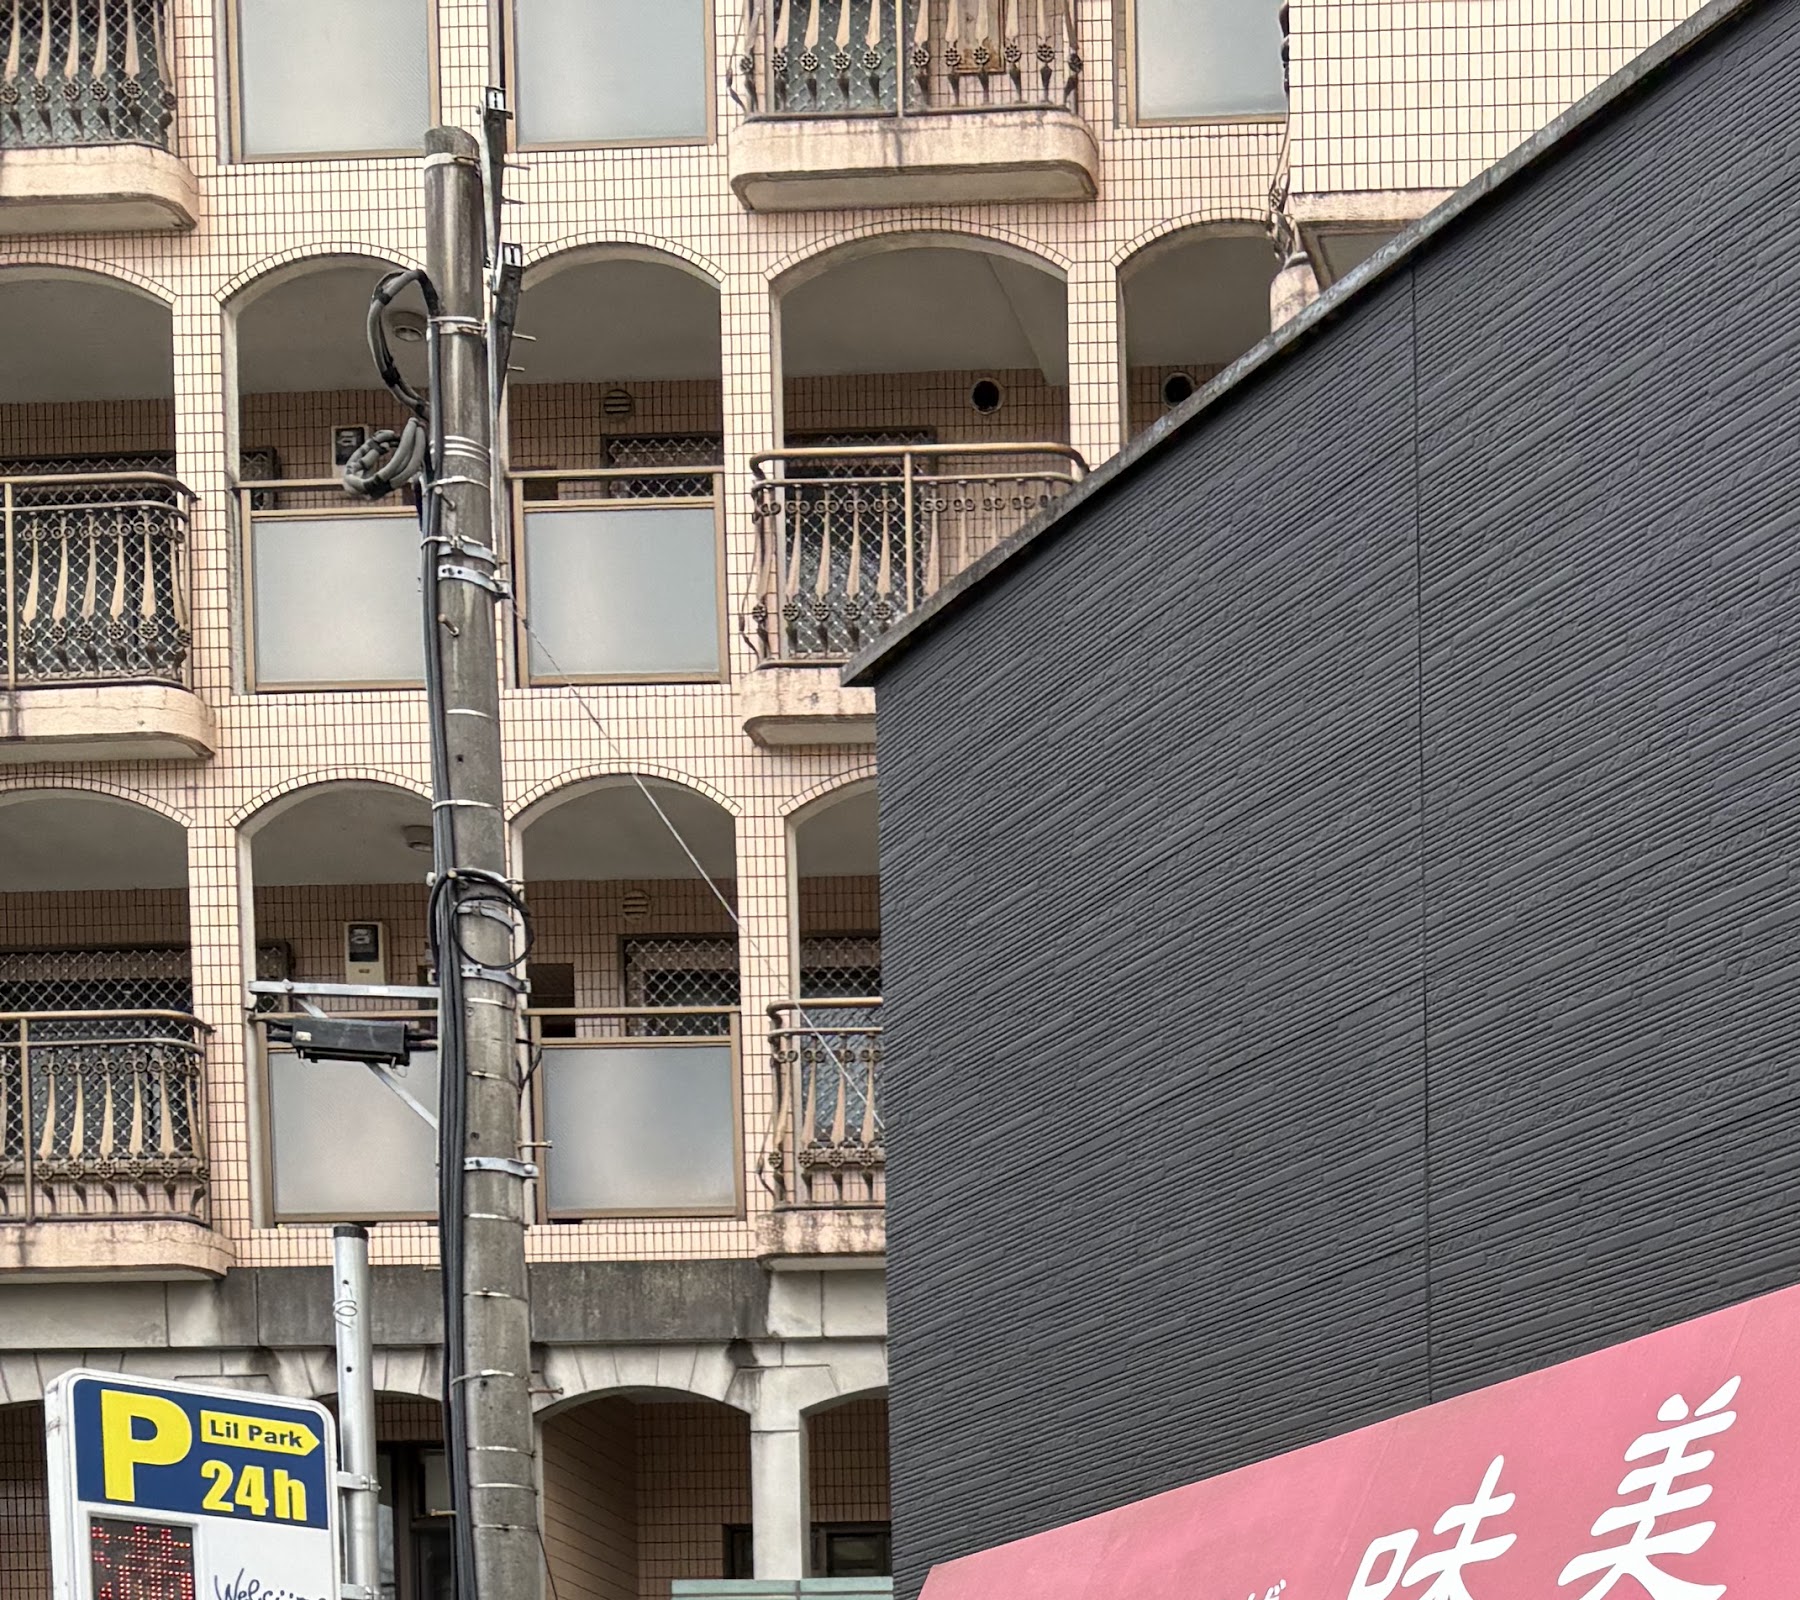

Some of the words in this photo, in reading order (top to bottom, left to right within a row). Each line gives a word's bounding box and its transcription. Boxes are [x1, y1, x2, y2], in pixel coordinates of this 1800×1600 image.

[101, 1389, 193, 1503] P
[209, 1419, 239, 1440] Lil
[247, 1423, 303, 1448] Park
[200, 1460, 308, 1522] 24h
